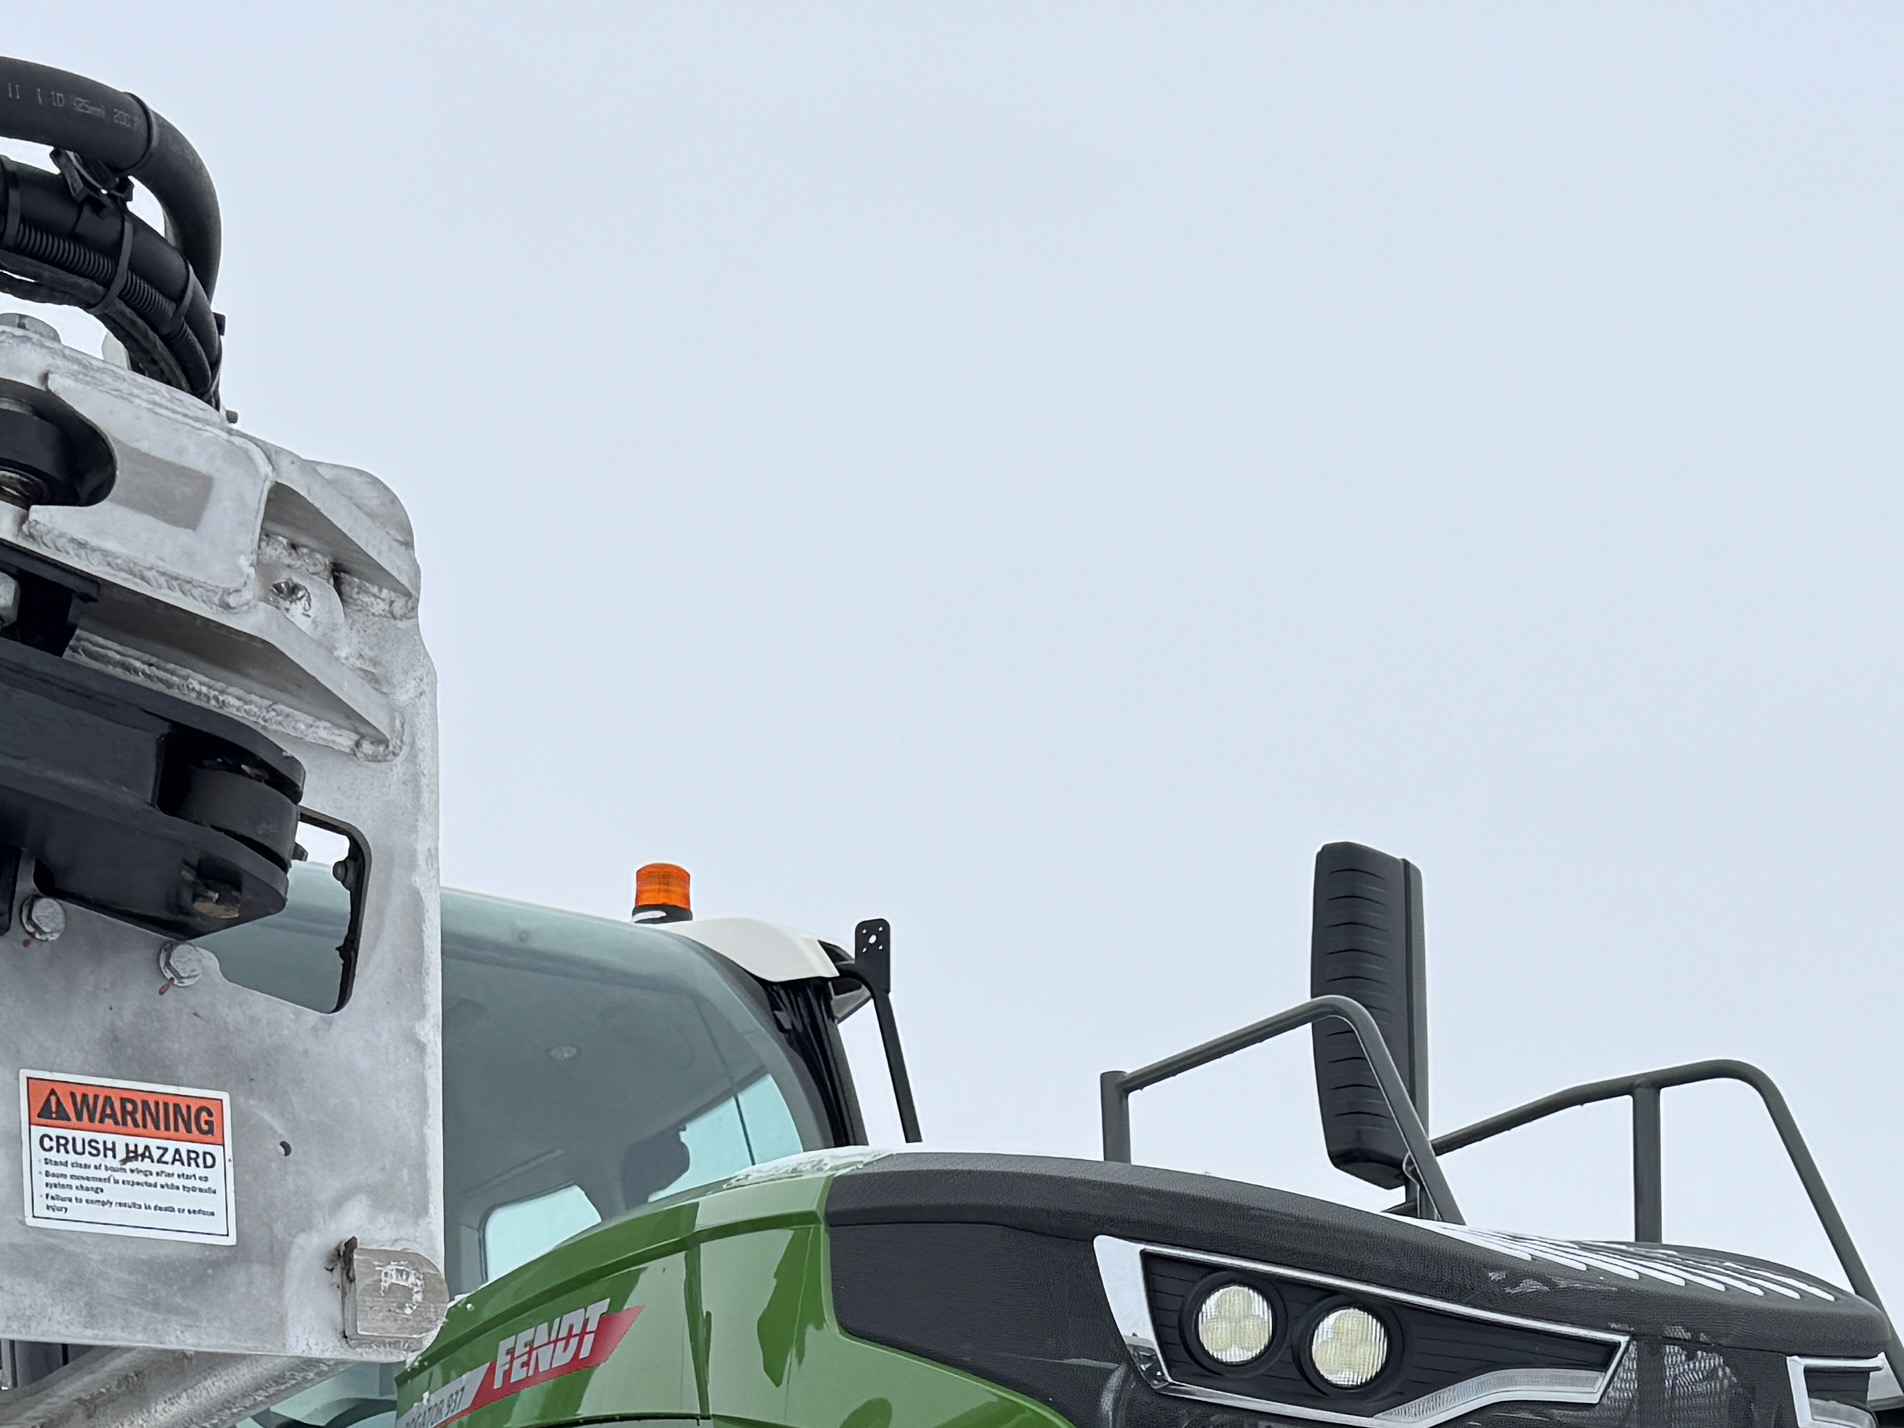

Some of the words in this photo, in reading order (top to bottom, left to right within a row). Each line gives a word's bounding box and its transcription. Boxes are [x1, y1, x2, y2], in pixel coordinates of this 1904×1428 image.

[70, 1091, 215, 1136] WARNING
[39, 1134, 117, 1159] CRUSH
[124, 1142, 216, 1169] HAZARD
[493, 1298, 611, 1390] FENDT
